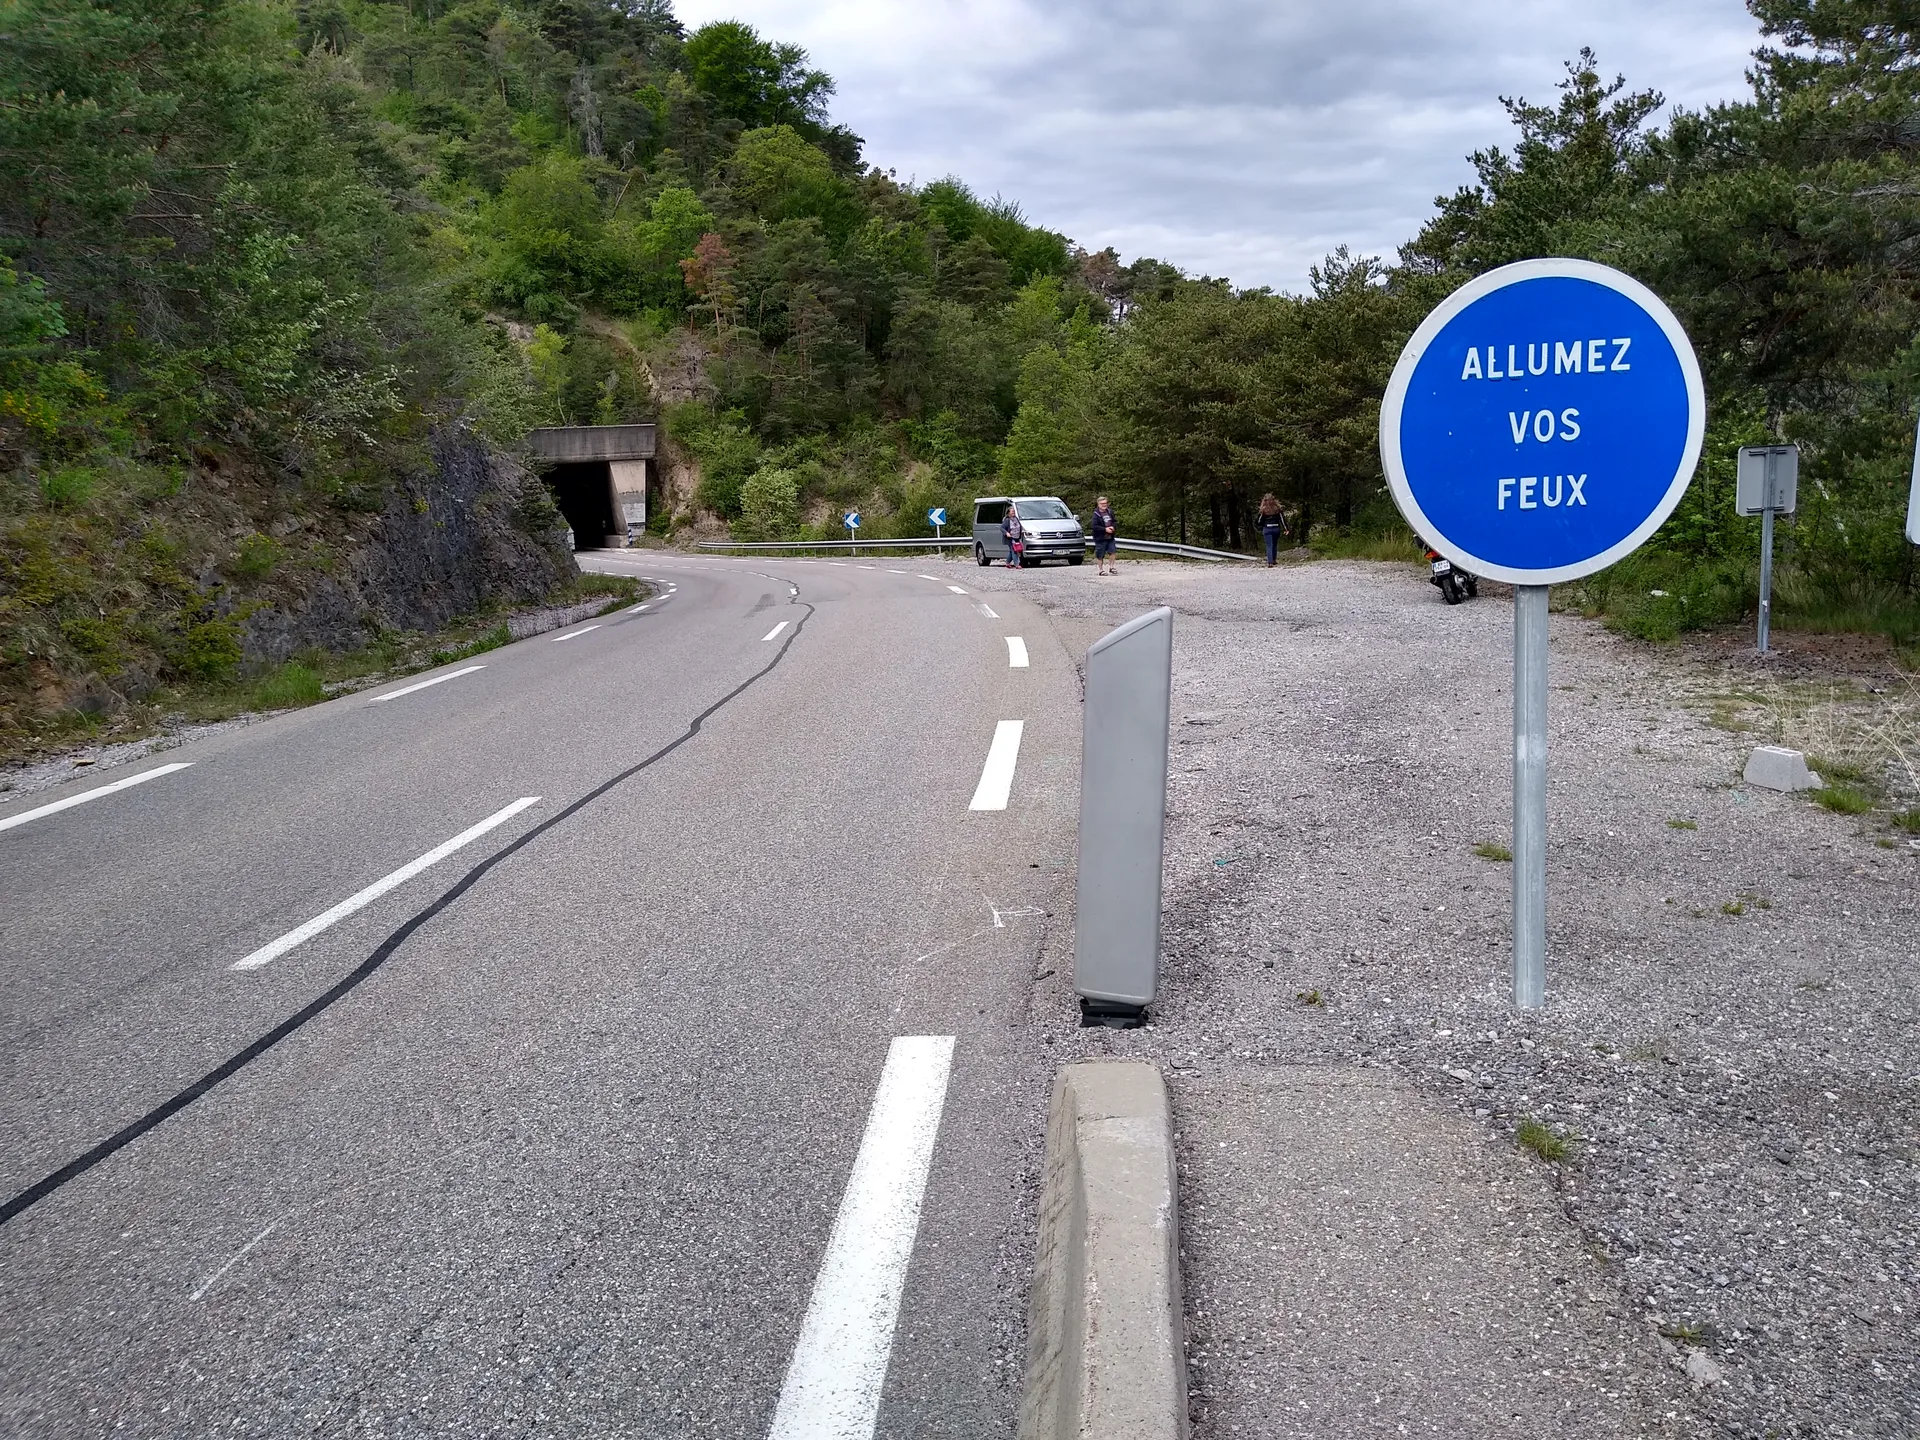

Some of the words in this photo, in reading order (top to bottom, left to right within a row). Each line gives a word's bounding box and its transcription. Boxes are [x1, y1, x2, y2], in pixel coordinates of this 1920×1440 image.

[1461, 337, 1632, 380] ALLUMEZ
[1508, 408, 1581, 444] VOS
[1498, 474, 1588, 510] FEUX
